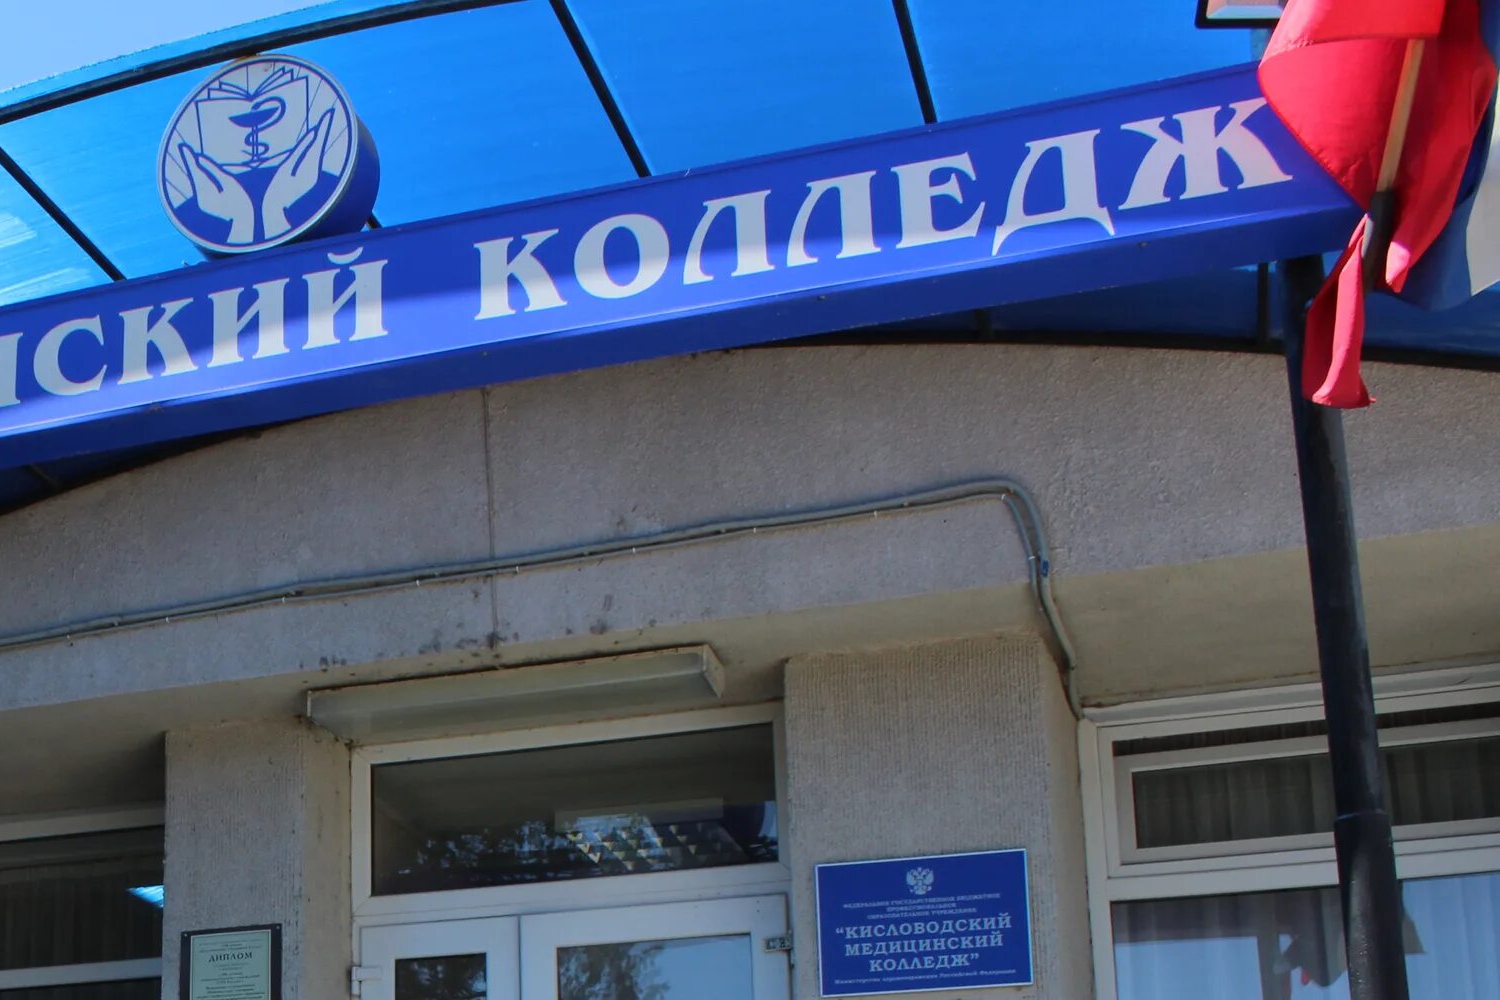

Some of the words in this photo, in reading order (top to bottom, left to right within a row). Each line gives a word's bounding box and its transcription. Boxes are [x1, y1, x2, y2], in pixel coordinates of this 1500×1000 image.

[473, 97, 1293, 321] КОЛЛЕДЖ
[208, 951, 253, 963] ДИПЛОМ
[844, 931, 1004, 957] МЕДИЦИНСКИЙ
